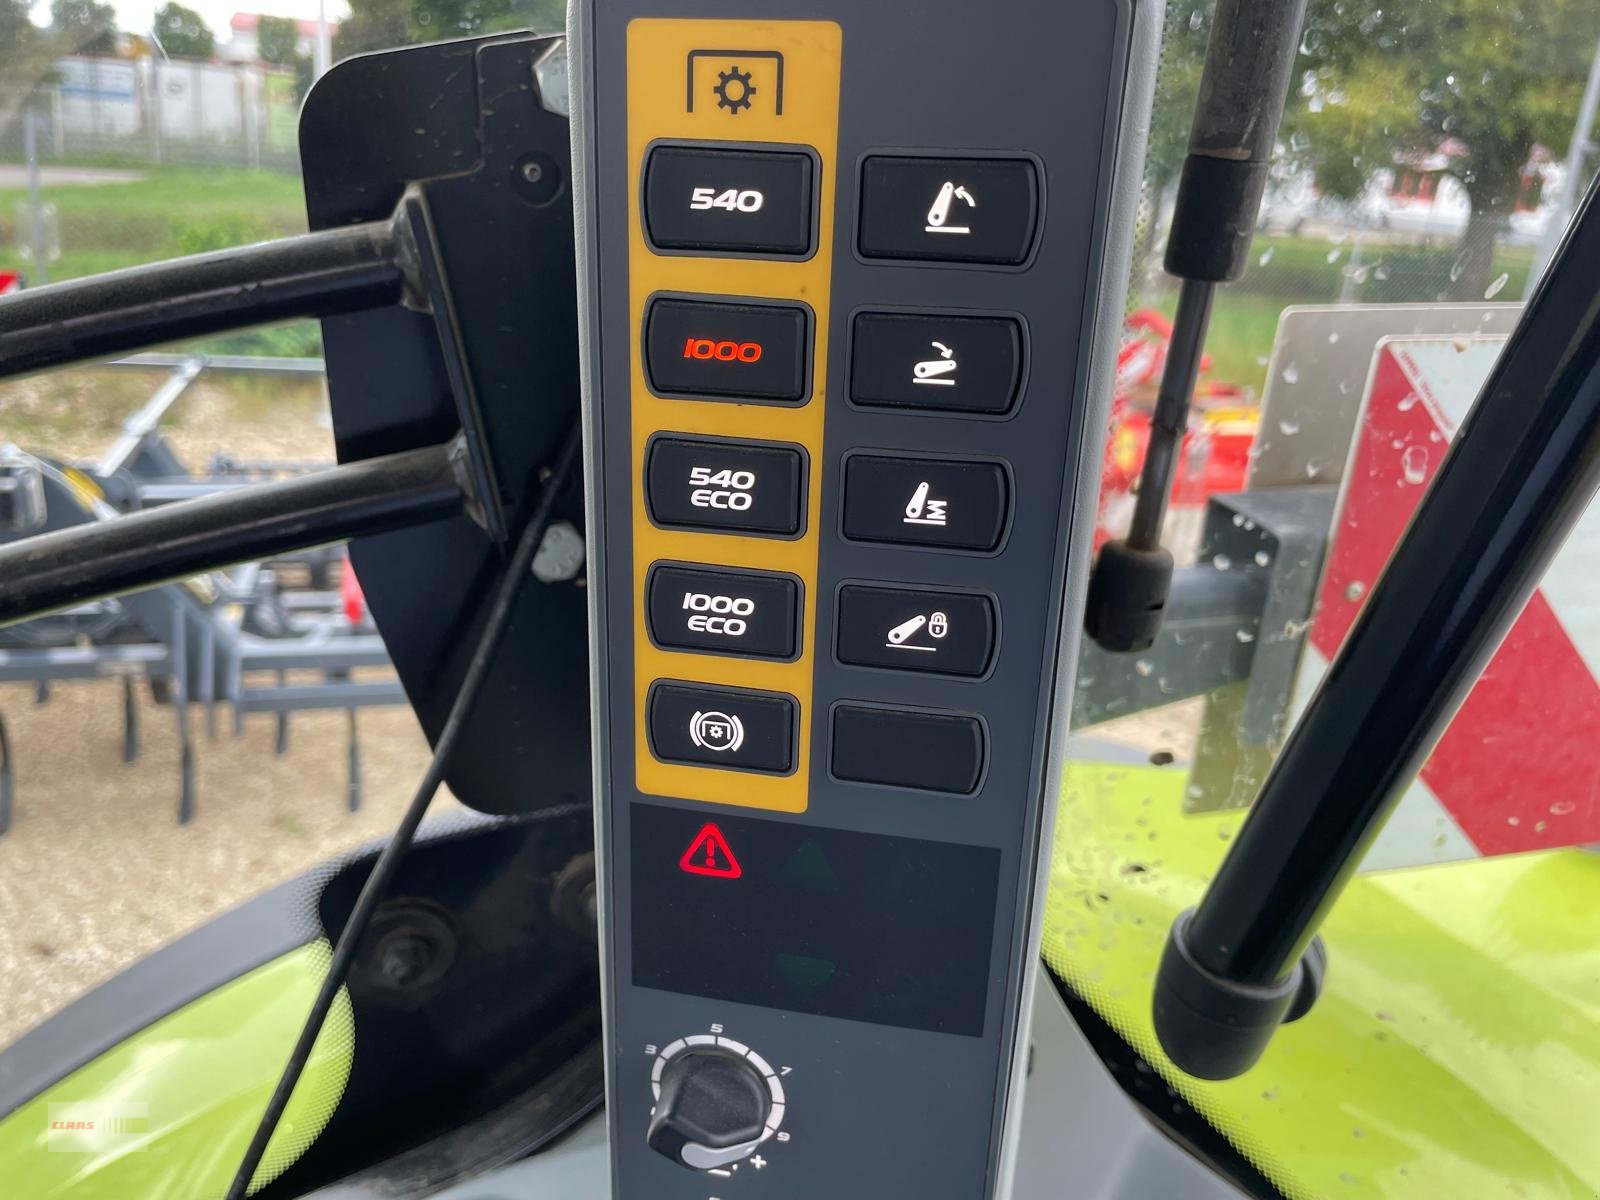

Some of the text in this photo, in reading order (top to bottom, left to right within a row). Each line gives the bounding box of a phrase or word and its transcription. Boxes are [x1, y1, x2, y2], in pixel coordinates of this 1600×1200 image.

[689, 187, 764, 213] 540
[683, 337, 763, 363] 1000
[688, 466, 756, 490] 540
[690, 488, 753, 511] ECO
[682, 592, 755, 616] 1000
[687, 614, 747, 636] ECO
[709, 1022, 724, 1034] 5
[644, 1043, 658, 1055] 3
[779, 1065, 793, 1076] 7
